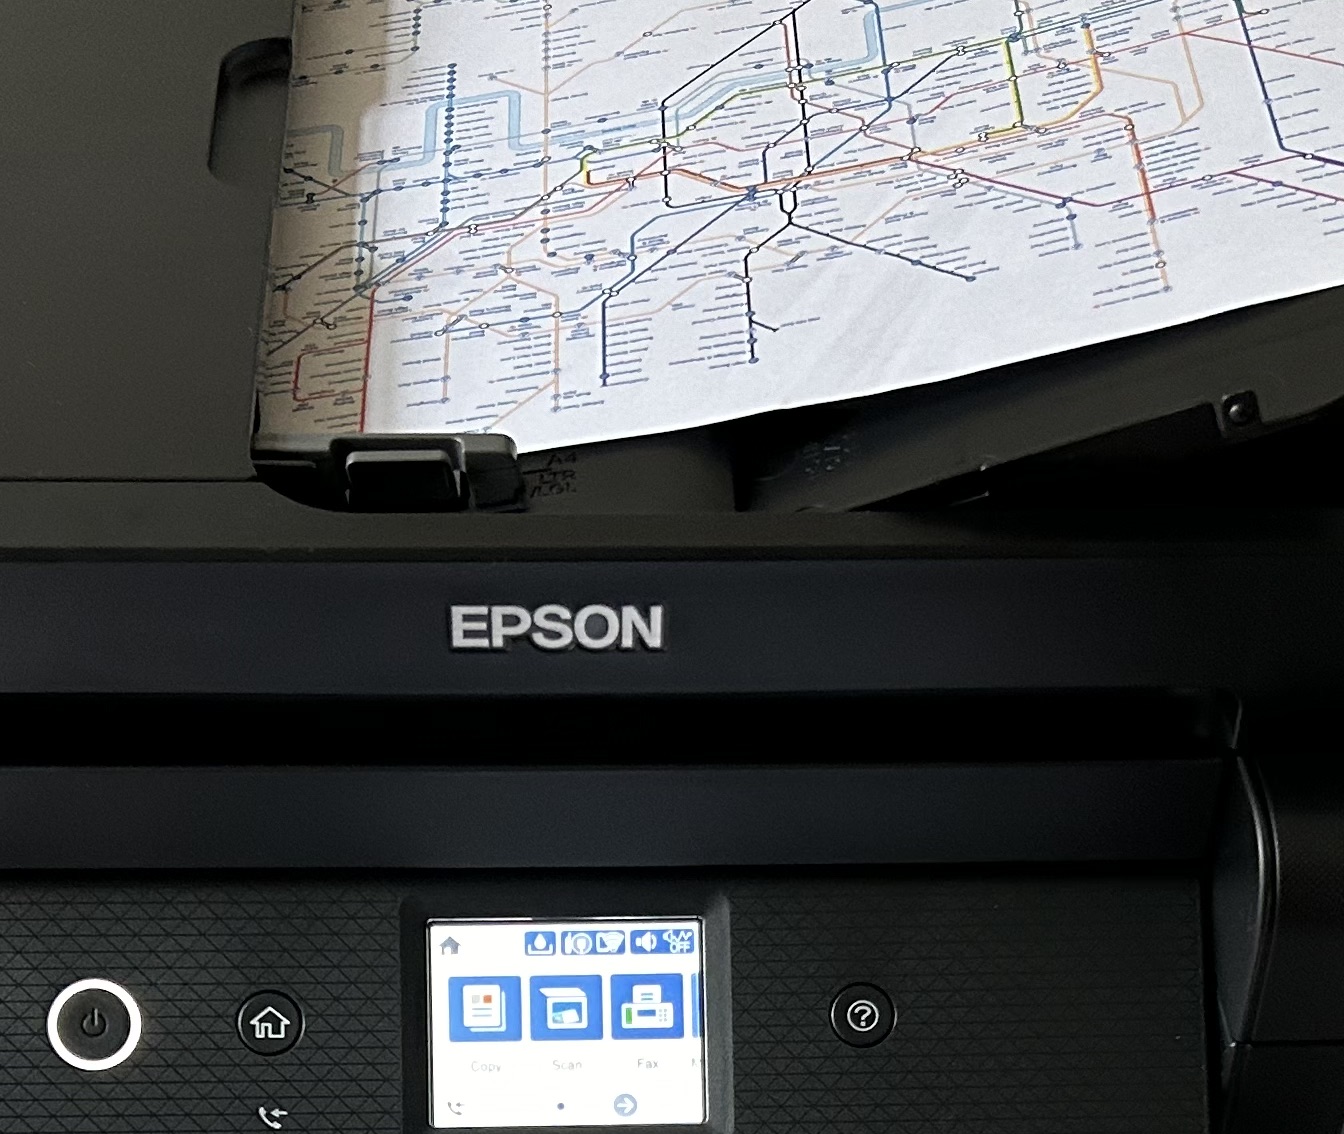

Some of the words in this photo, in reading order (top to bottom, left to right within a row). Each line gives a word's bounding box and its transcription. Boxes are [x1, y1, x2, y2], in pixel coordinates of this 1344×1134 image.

[450, 604, 663, 649] EPSON
[471, 1059, 502, 1073] Copy
[552, 1059, 583, 1071] Scan
[637, 1058, 659, 1069] Fax
